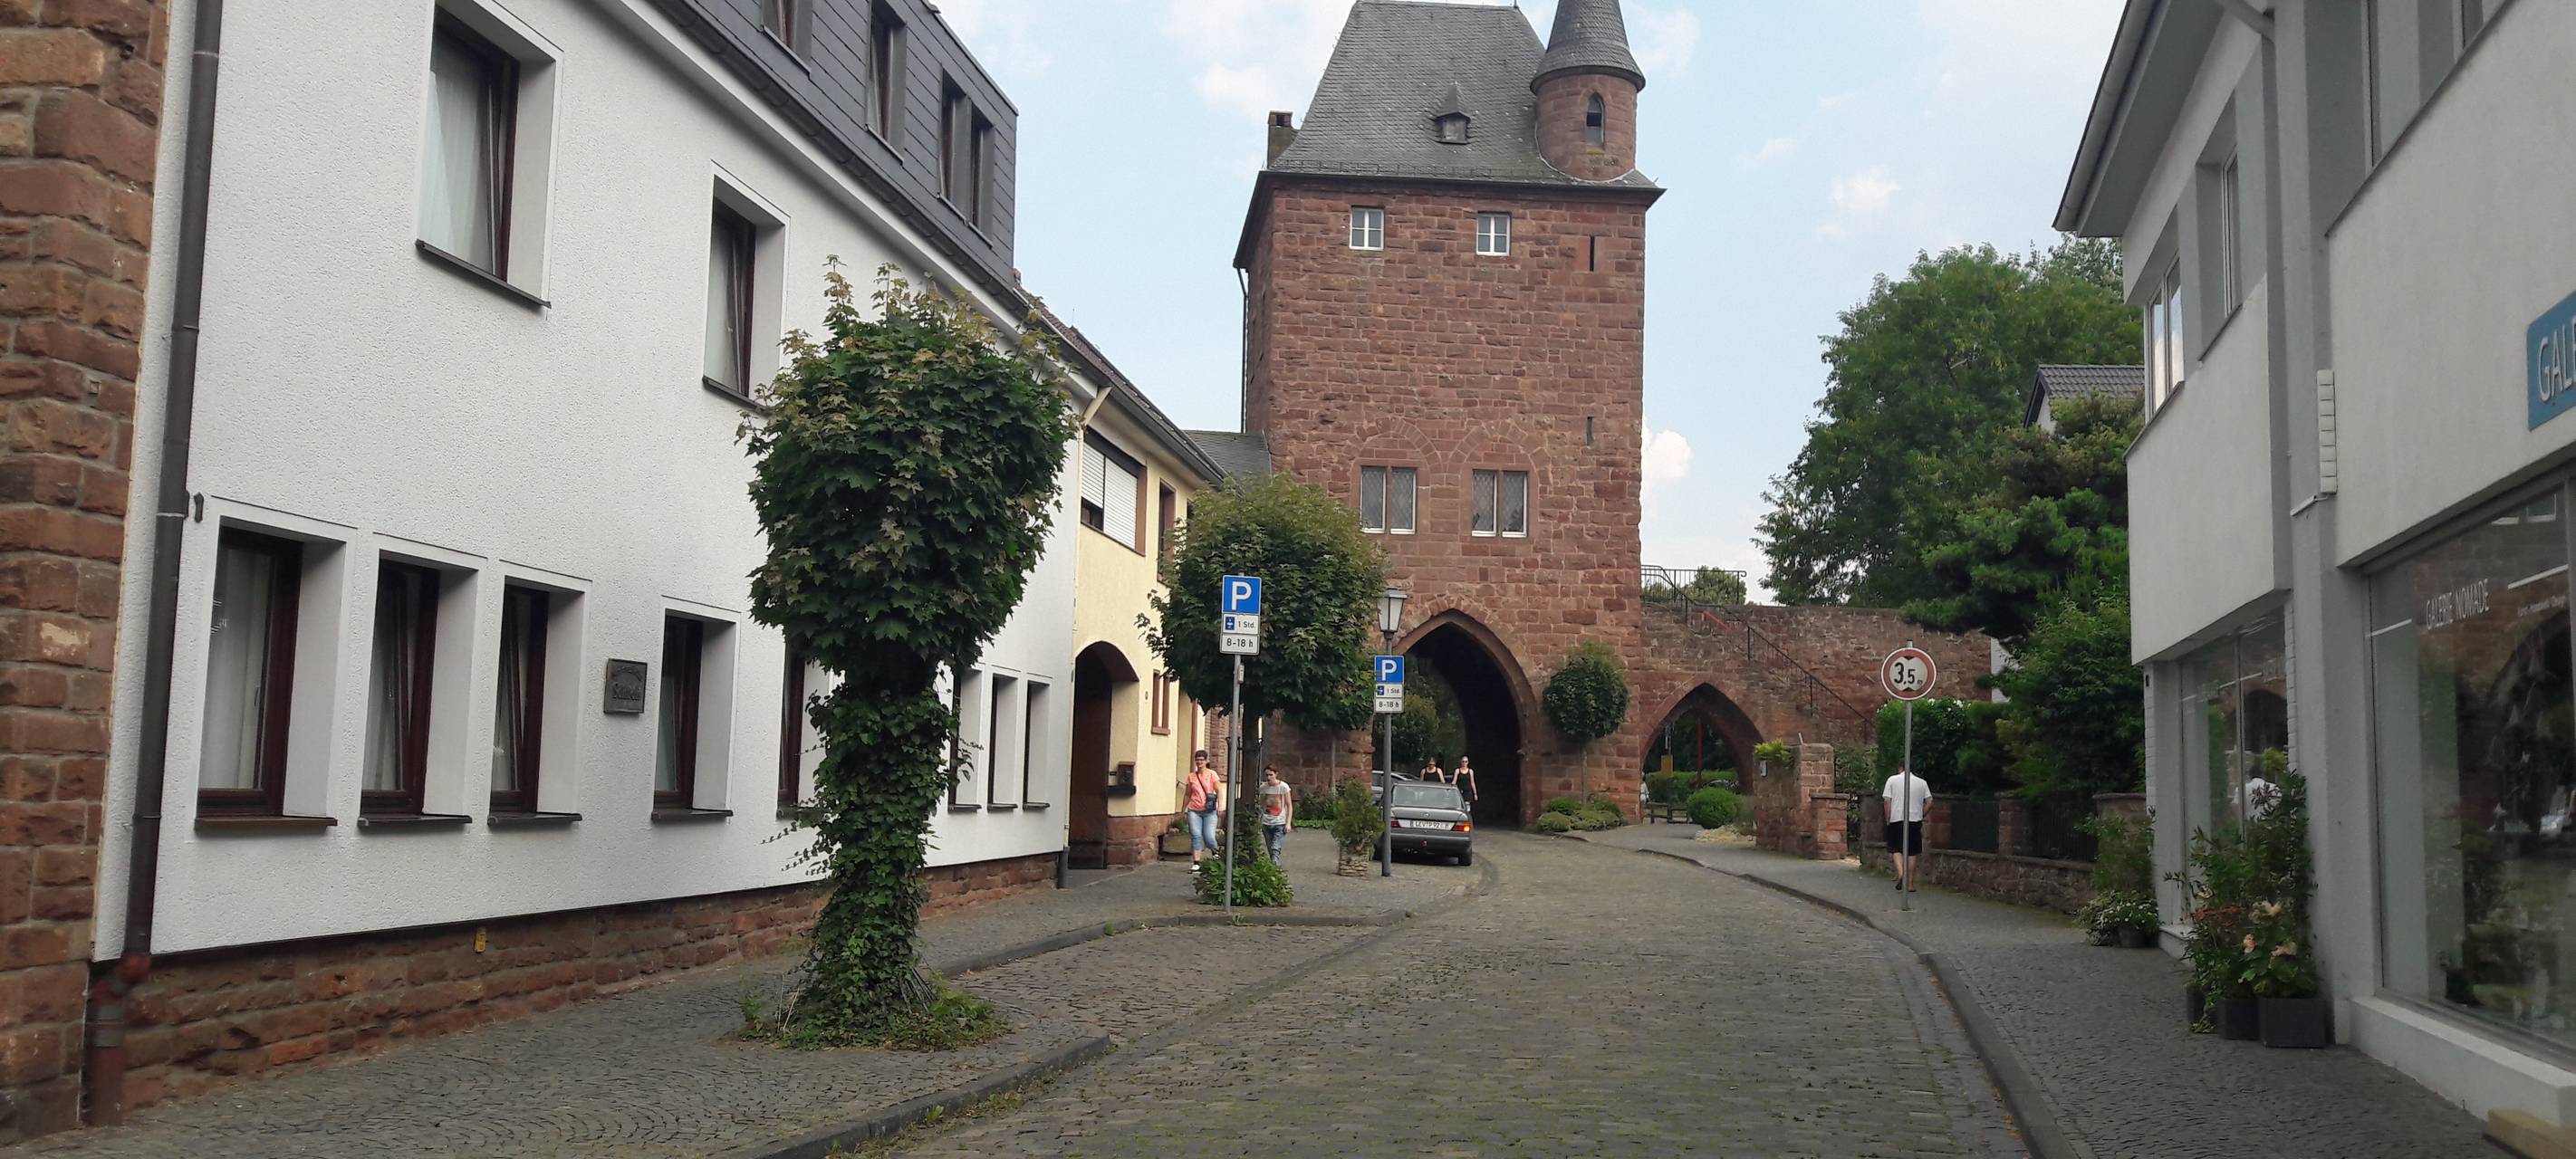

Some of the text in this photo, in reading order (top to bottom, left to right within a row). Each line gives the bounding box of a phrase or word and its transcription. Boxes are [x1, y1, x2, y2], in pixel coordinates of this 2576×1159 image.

[1231, 580, 1252, 610] P
[2456, 579, 2489, 620] NOMADE
[1226, 637, 1254, 647] 8-18 h
[1381, 659, 1397, 681] P
